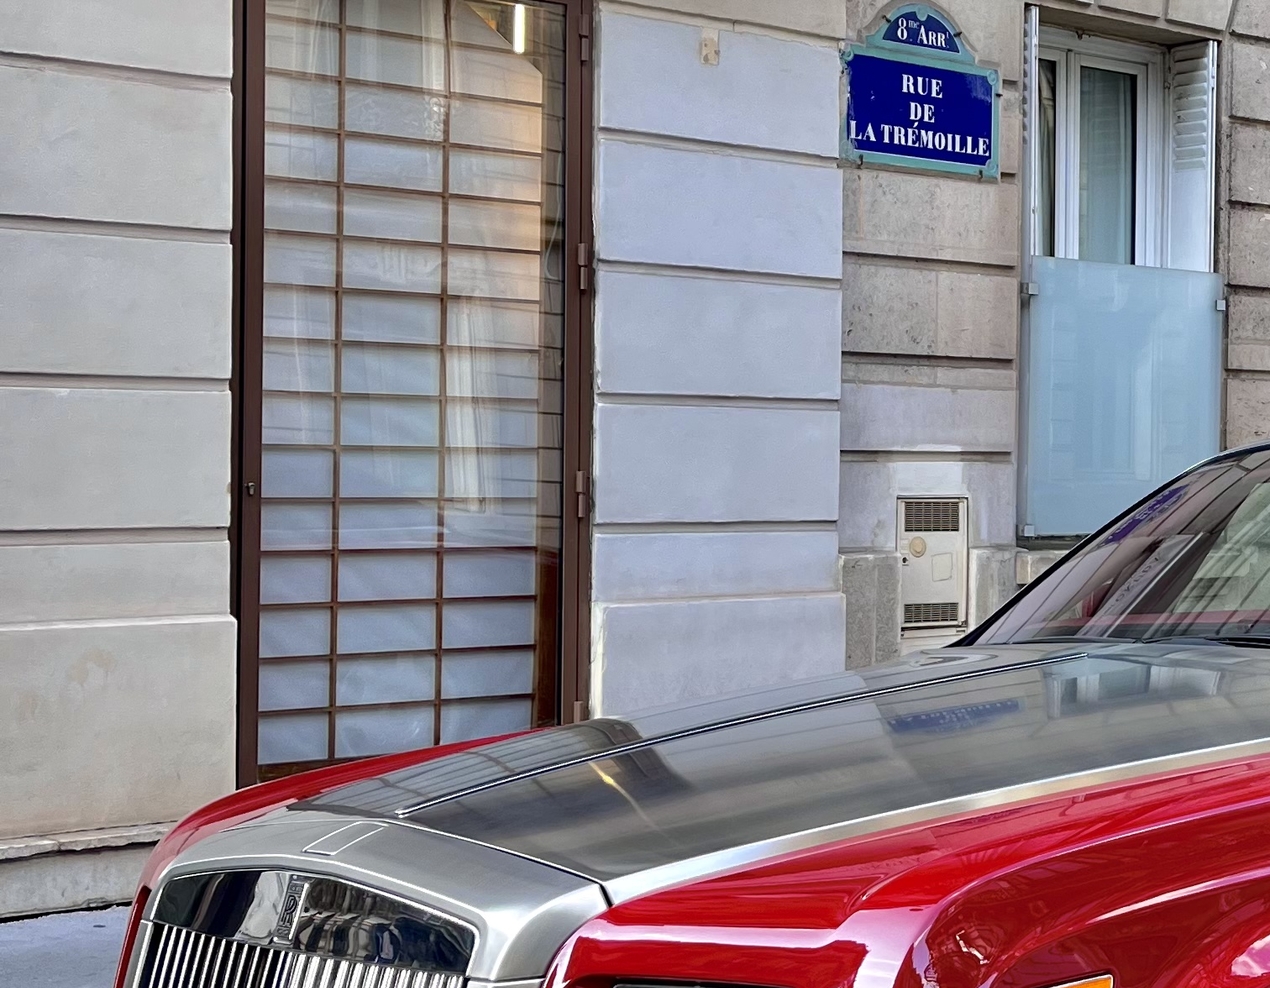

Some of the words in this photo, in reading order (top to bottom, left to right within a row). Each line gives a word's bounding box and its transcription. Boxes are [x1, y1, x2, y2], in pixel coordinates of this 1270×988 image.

[902, 74, 943, 99] RUE
[909, 101, 935, 123] DE
[850, 120, 876, 142] LA
[880, 122, 990, 157] TRÉMOILLE
